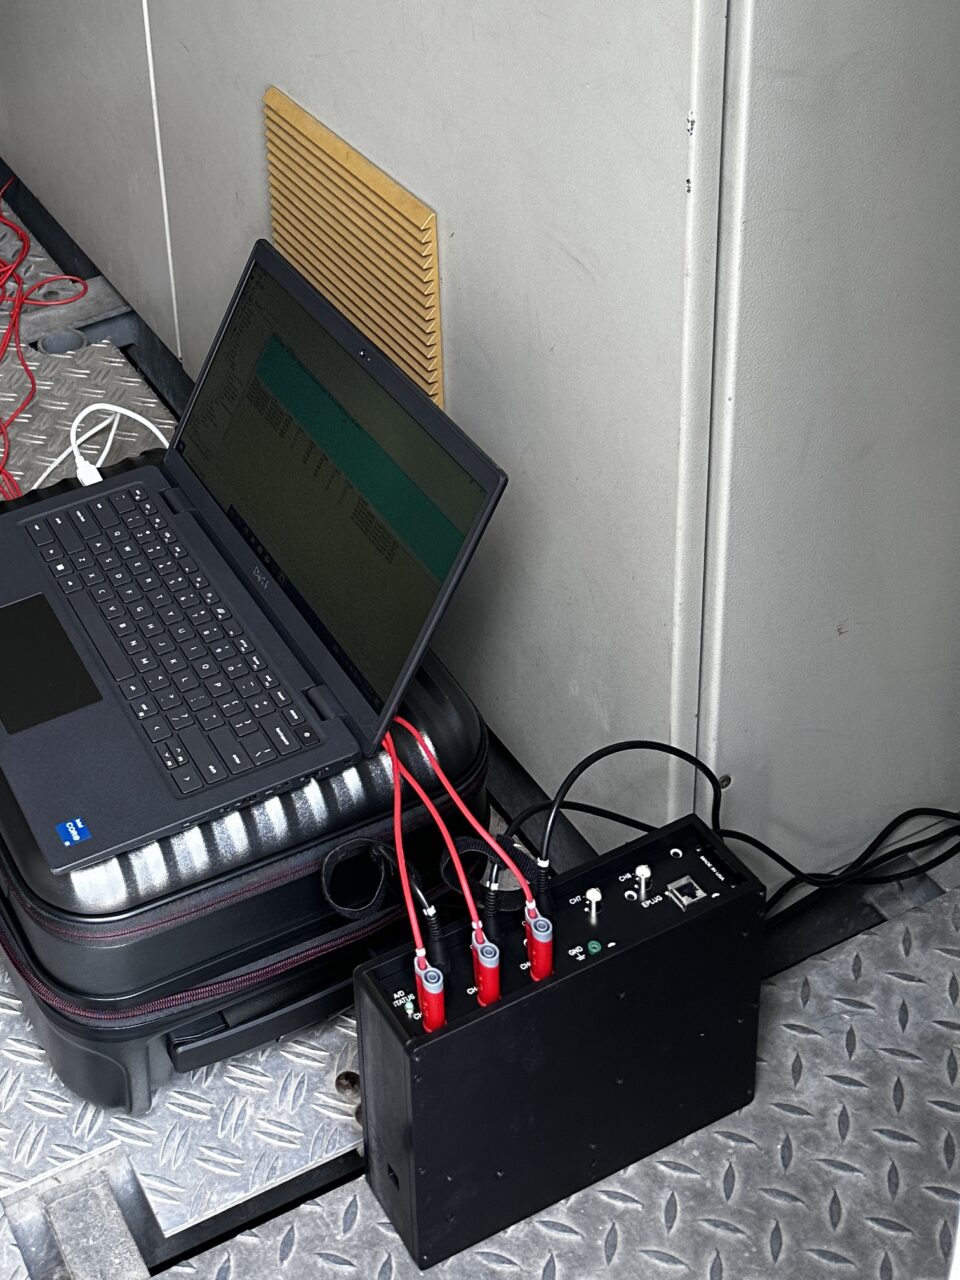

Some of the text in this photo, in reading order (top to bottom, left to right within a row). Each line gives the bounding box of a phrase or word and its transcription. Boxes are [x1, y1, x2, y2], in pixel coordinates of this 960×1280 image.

[568, 894, 582, 905] CH7
[641, 894, 663, 908] EPLUG
[568, 945, 584, 956] GND
[392, 989, 405, 1000] A/D
